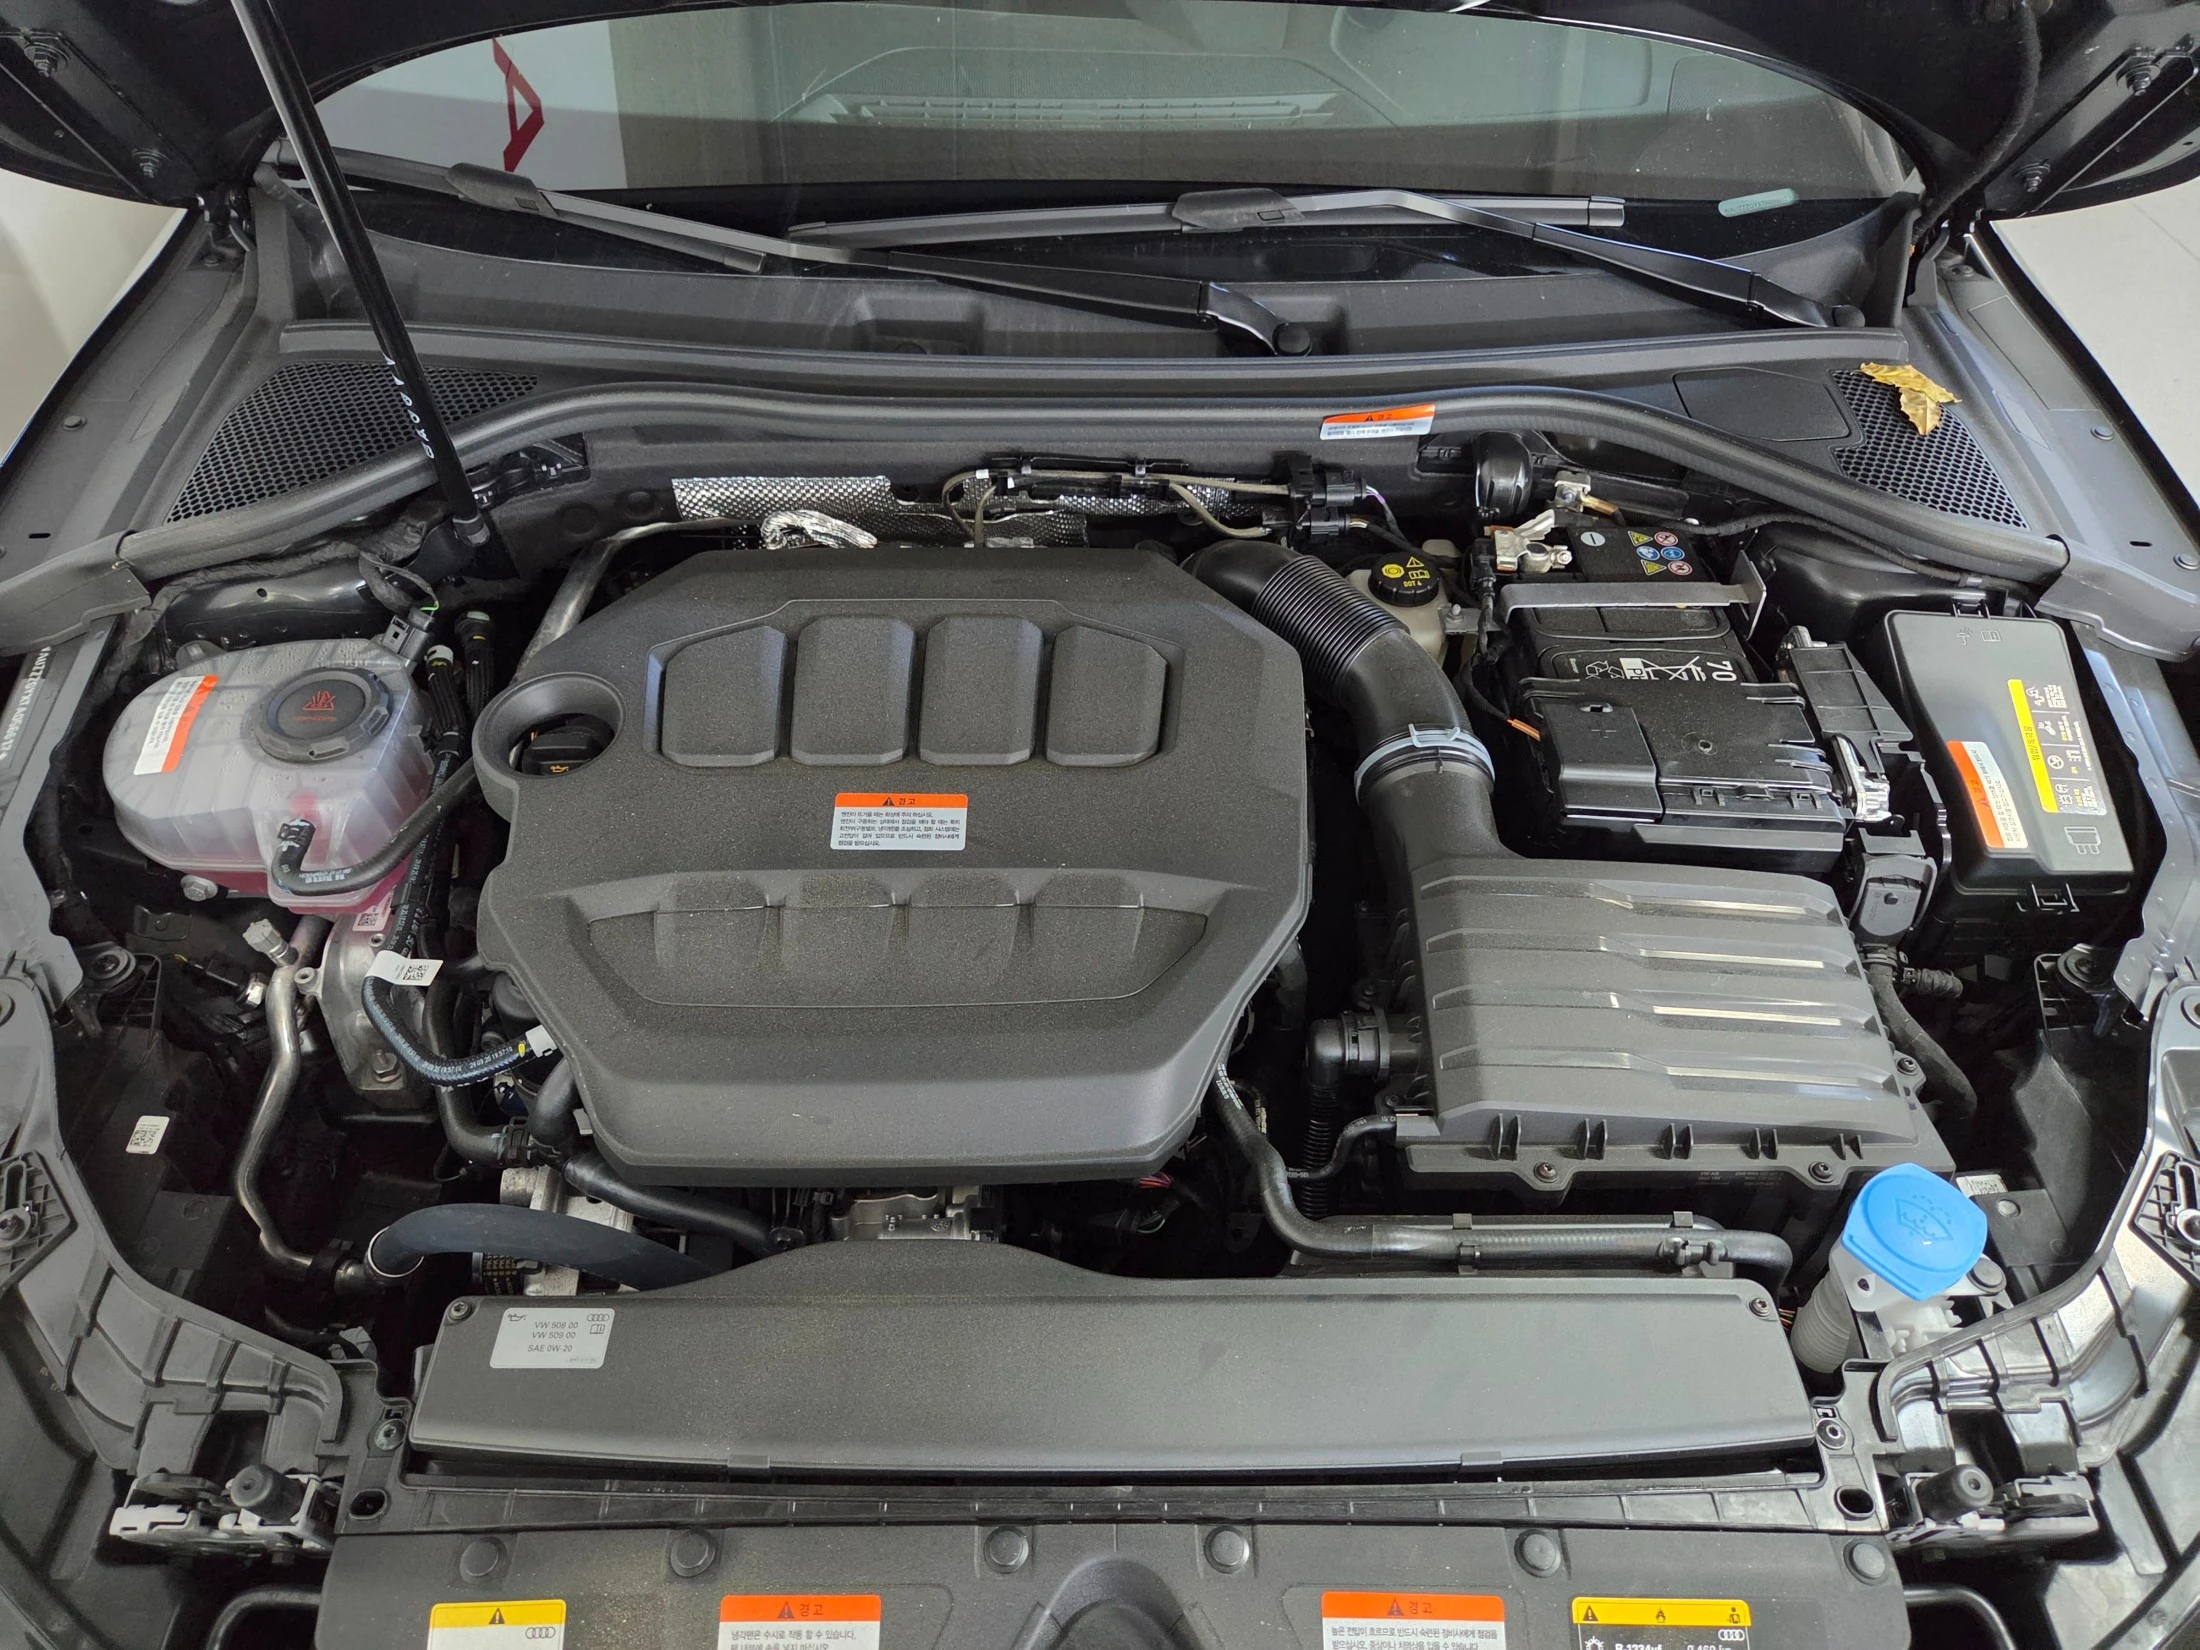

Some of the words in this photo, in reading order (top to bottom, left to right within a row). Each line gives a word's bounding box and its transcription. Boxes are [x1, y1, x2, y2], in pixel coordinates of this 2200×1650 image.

[1706, 660, 1738, 682] 70
[528, 1344, 545, 1352] SAE
[546, 1344, 572, 1352] 0W-20
[764, 1630, 786, 1640] 수시로
[815, 1630, 823, 1640] 수
